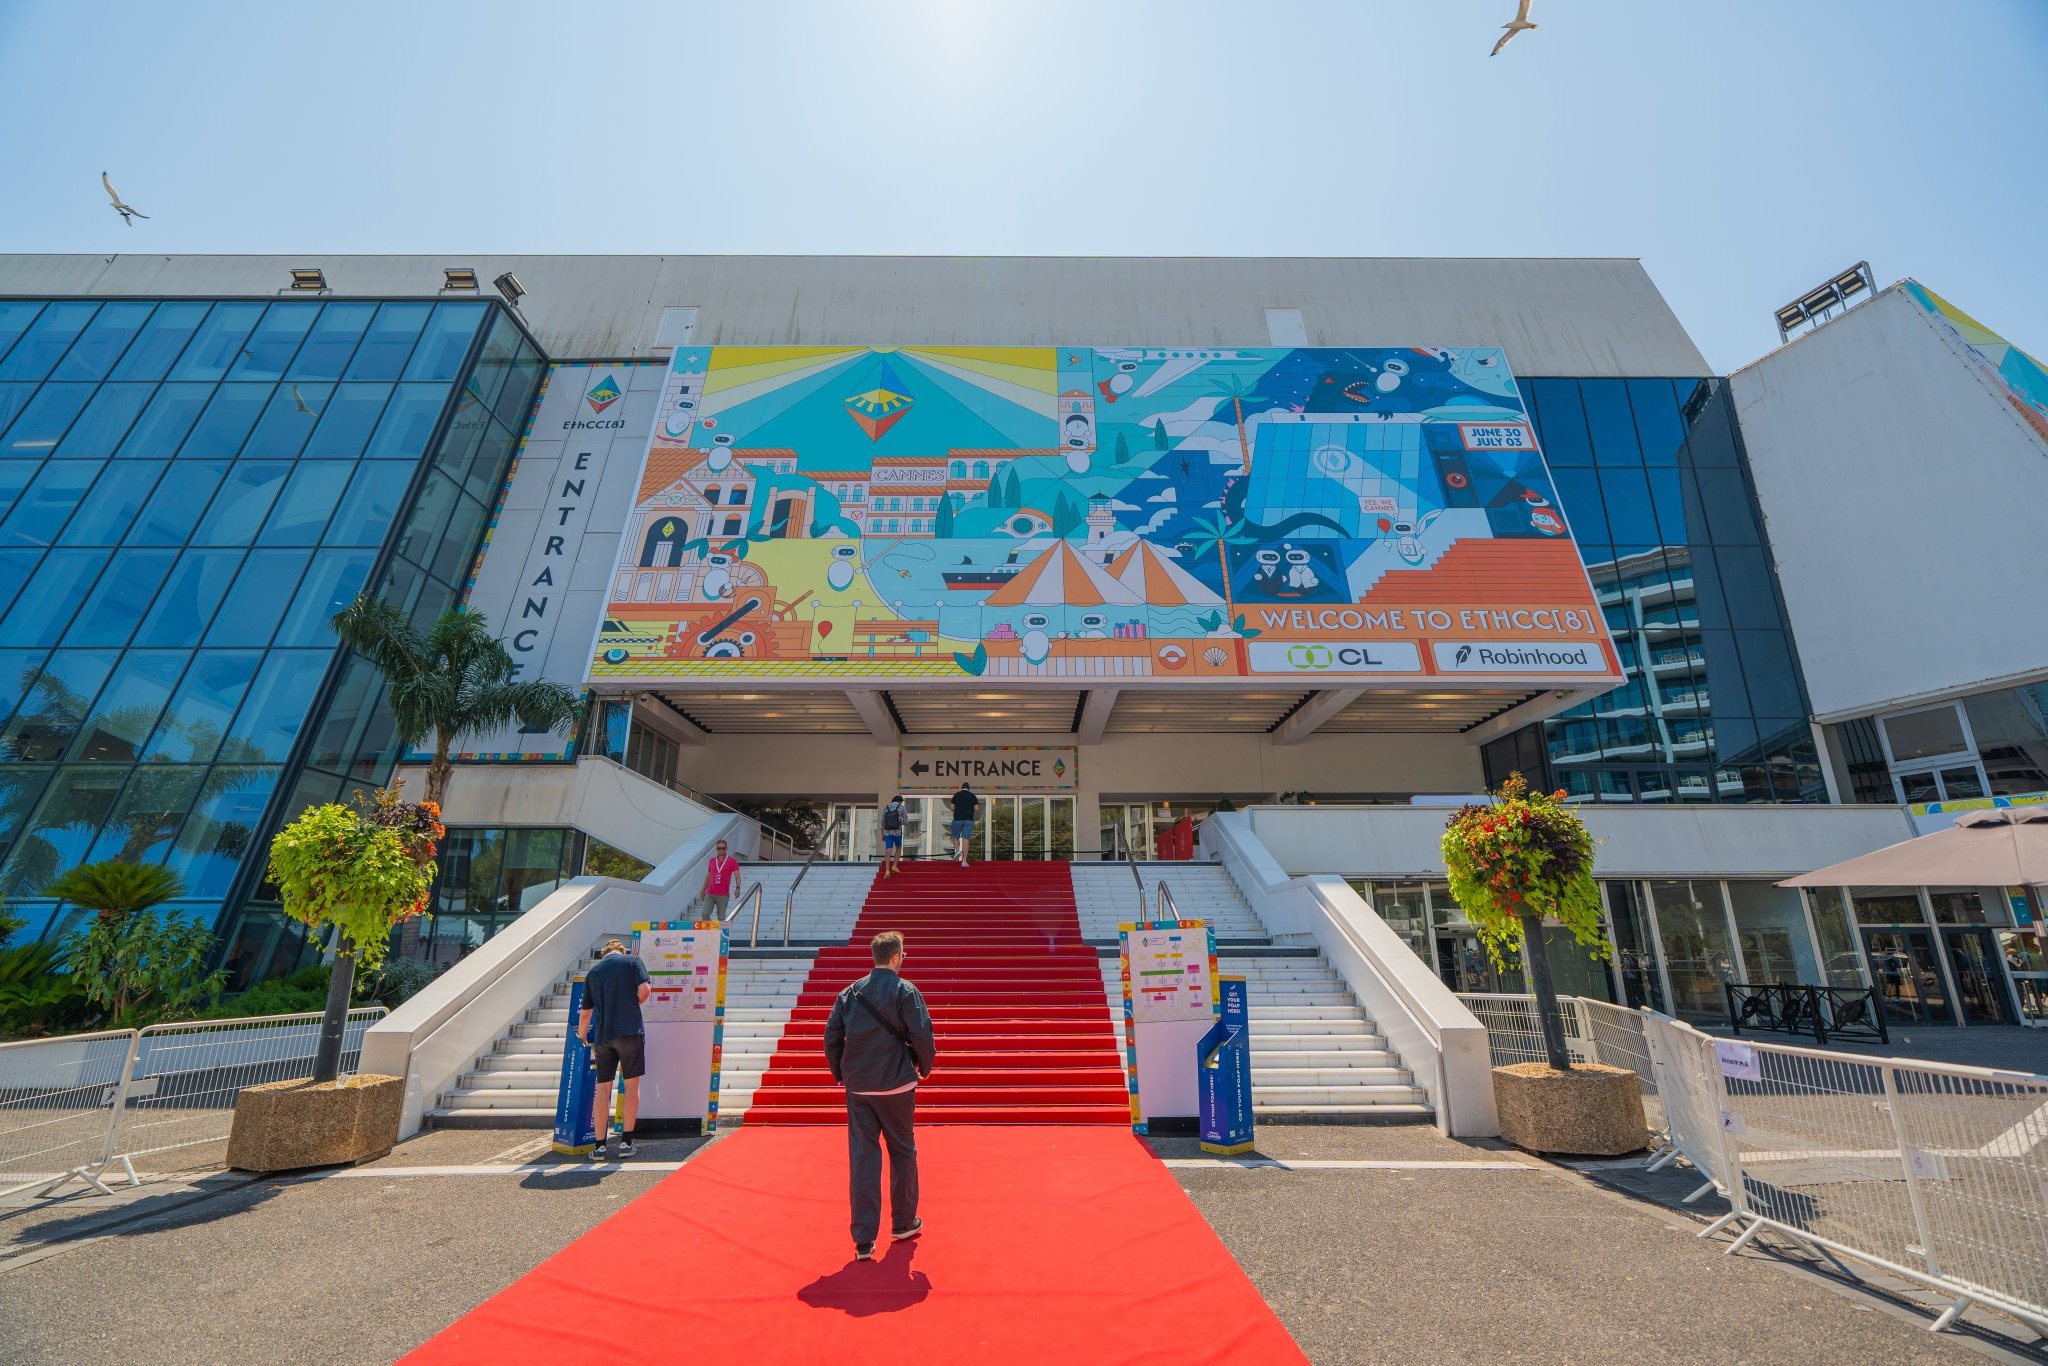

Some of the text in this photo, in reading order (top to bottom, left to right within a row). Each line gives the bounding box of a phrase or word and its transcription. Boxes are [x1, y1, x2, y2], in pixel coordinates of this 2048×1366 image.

[1471, 428, 1521, 437] JUNE 30
[1476, 438, 1523, 447] JULY 03
[875, 469, 945, 481] CANNES
[504, 452, 592, 686] ENTRANCE
[1259, 609, 1597, 634] WELCOME TO ETHCC[8]
[1338, 648, 1383, 666] CL
[1479, 648, 1588, 665] Robinhood
[935, 760, 1041, 776] ENTRANCE
